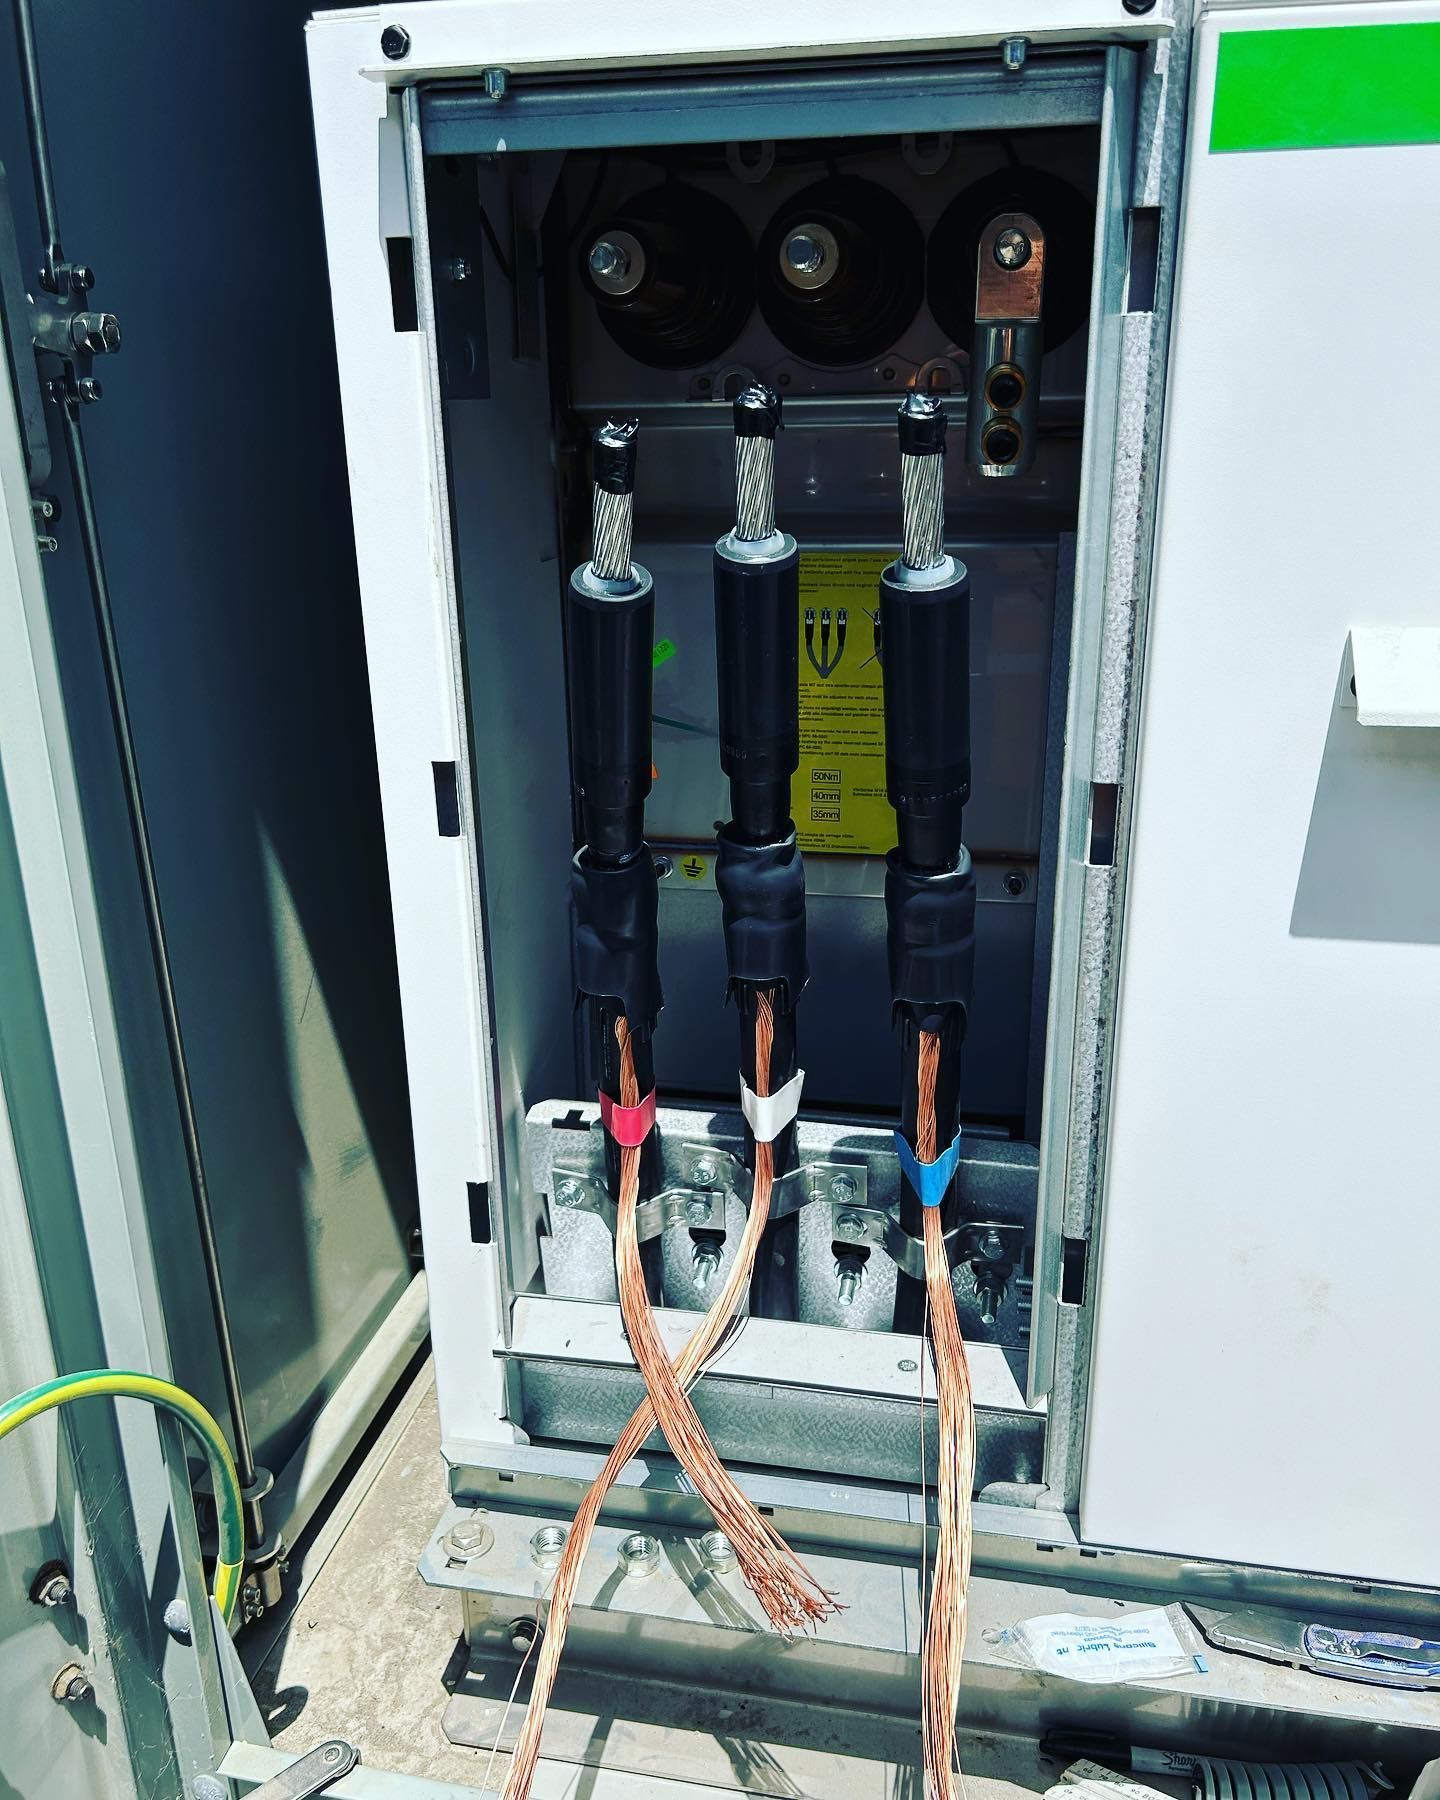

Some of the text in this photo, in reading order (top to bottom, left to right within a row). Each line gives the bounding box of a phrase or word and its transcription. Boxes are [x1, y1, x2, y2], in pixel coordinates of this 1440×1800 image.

[813, 772, 839, 781] 50Nm
[813, 792, 840, 801] 40mm
[813, 810, 840, 819] 35mm
